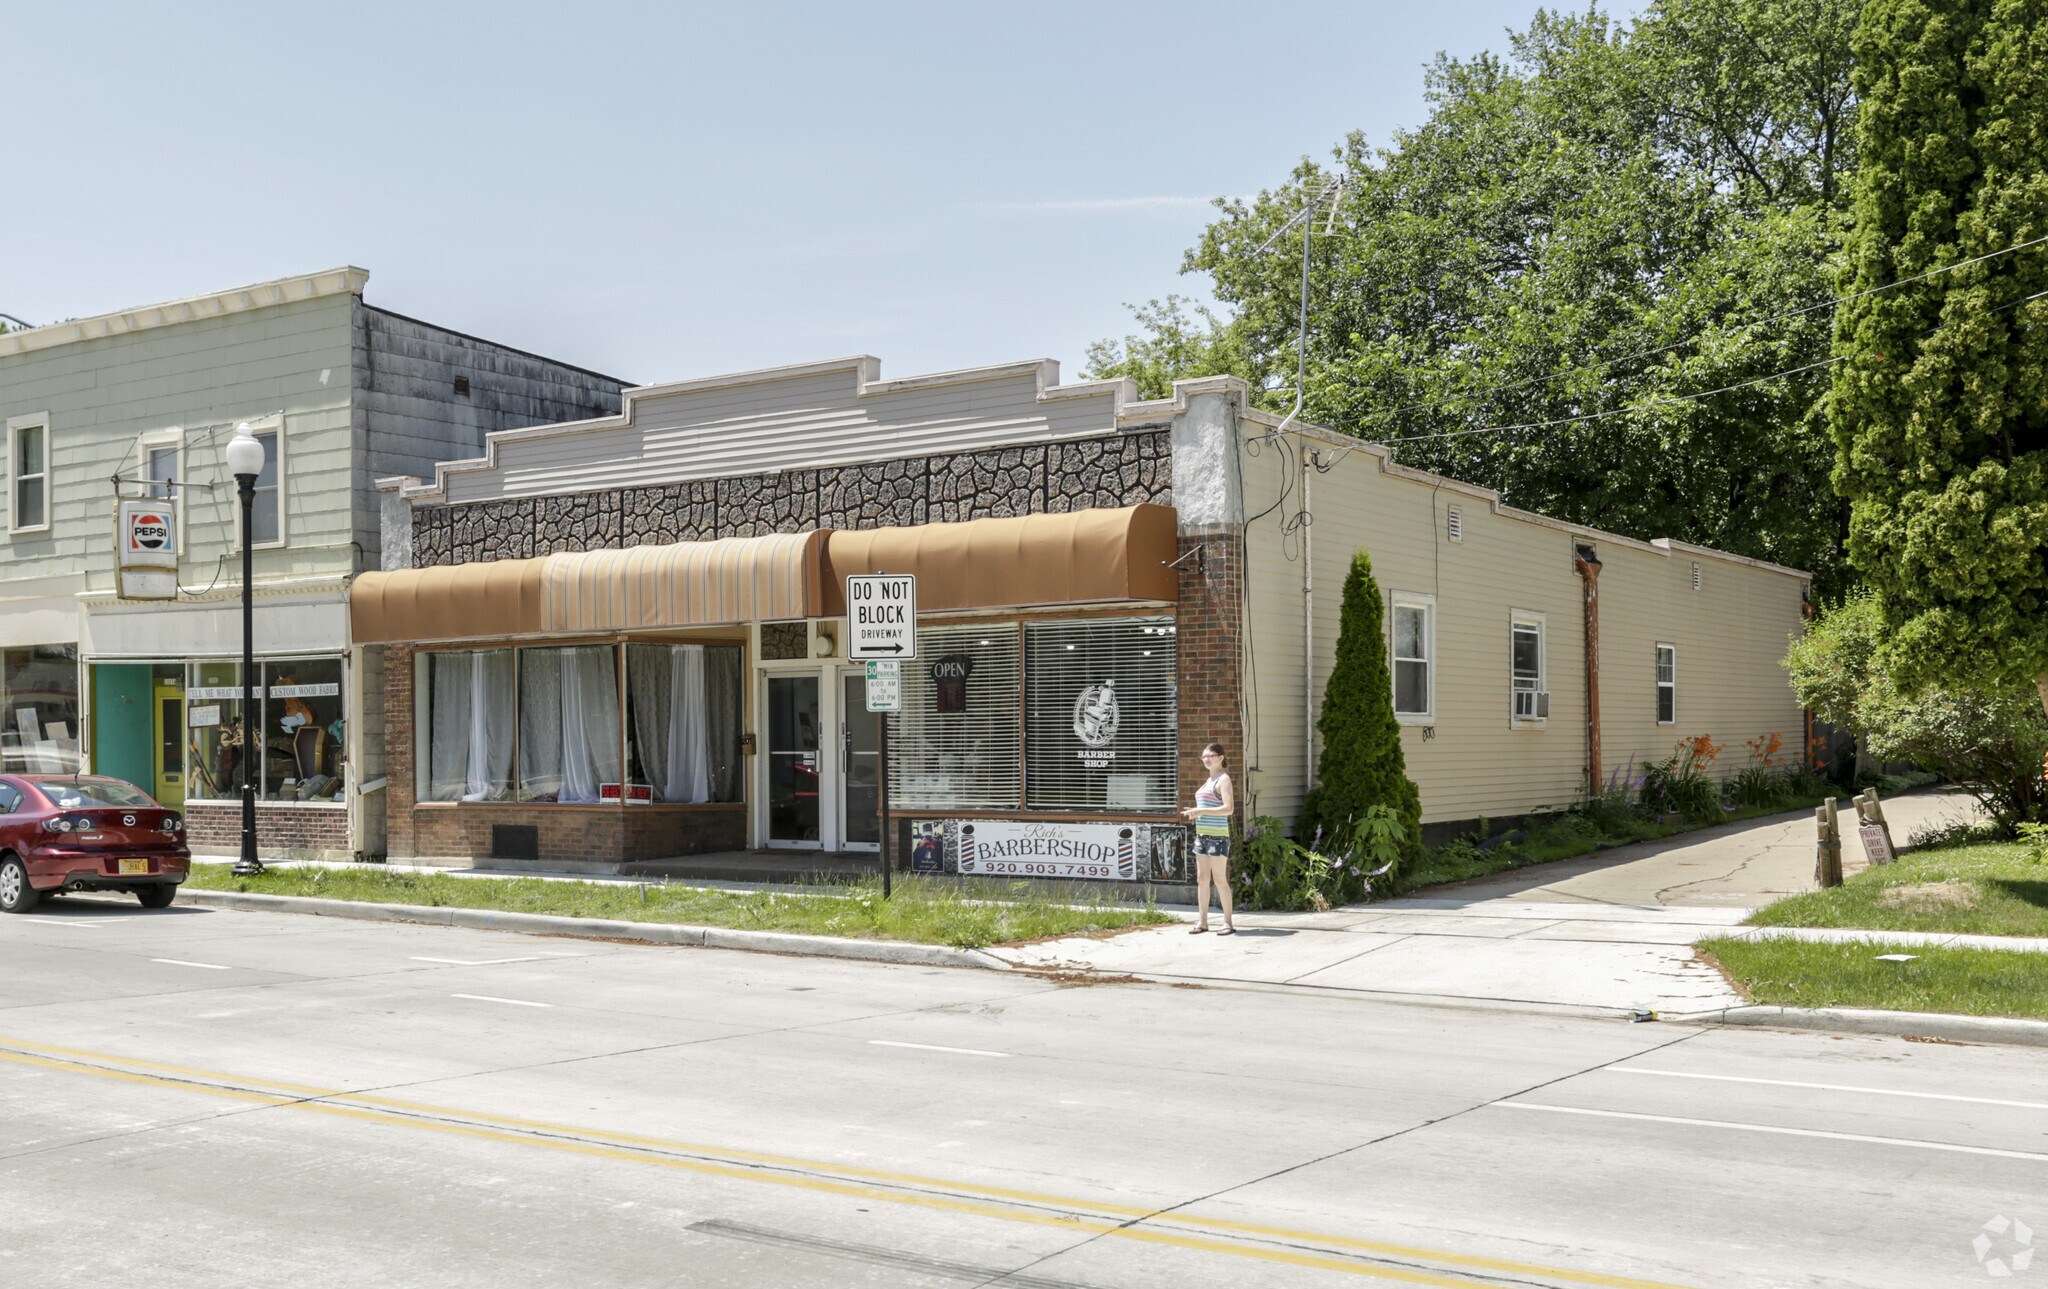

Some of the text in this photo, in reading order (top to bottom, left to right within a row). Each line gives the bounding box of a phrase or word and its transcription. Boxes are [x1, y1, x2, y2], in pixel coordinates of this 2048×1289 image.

[135, 527, 167, 537] PEPSI
[854, 581, 909, 600] DO NOT
[859, 605, 905, 624] BLOCK
[861, 629, 903, 639] DRIVEWAY
[867, 665, 877, 676] 30
[934, 662, 965, 678] OPEN
[205, 688, 214, 697] ME
[216, 688, 232, 697] WHAT
[270, 688, 296, 697] CUSTOM
[299, 686, 317, 696] WOOD
[1077, 750, 1116, 759] BARBER
[1084, 759, 1108, 768] SHOP
[1023, 823, 1065, 838] Rich's
[978, 838, 1116, 863] BARBERSHOP
[1871, 848, 1885, 857] KEEP
[986, 862, 1110, 877] 920.903.7499
